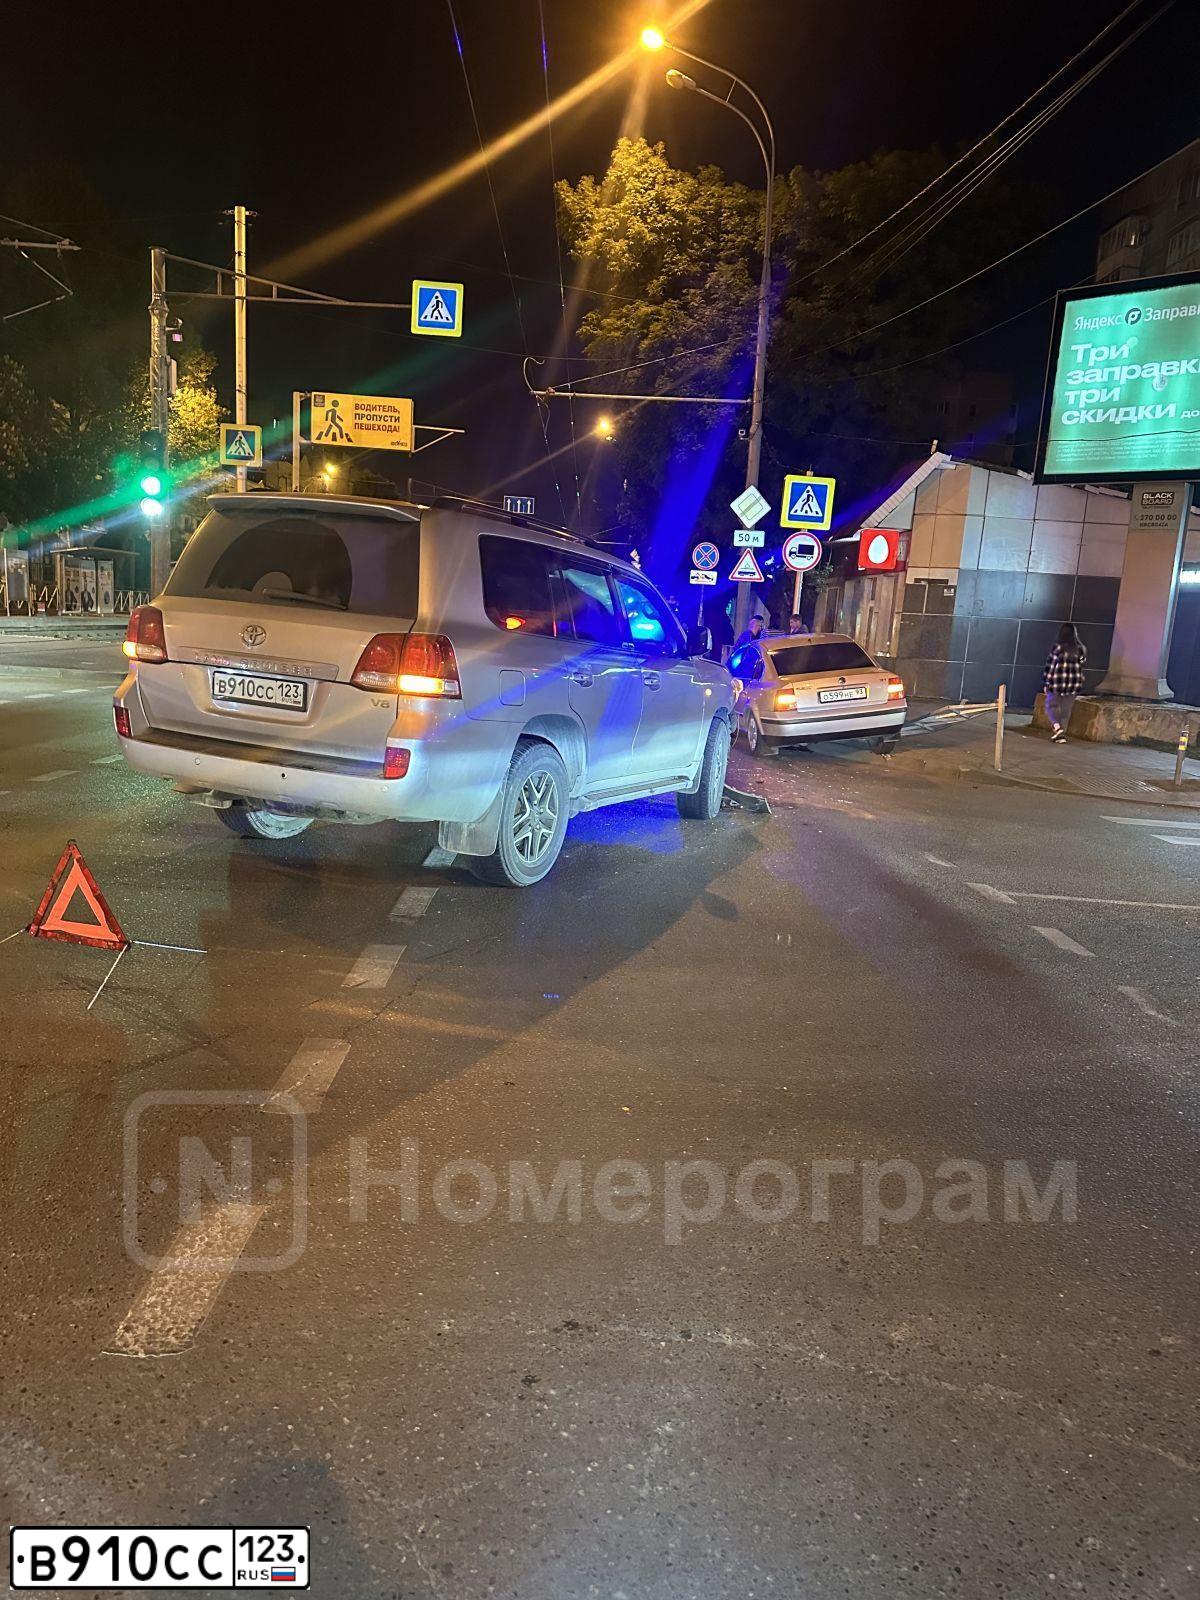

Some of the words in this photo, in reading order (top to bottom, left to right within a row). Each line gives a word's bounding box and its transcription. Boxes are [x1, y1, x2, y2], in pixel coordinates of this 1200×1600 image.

[1074, 313, 1122, 331] Яндекс
[1070, 343, 1131, 367] Три
[1066, 358, 1200, 385] заправк
[1064, 386, 1121, 409] три
[354, 403, 401, 414] ВОДИТЕЛЬ,
[354, 412, 400, 423] ПРОПУСТИ
[1061, 402, 1177, 425] скидки
[1180, 409, 1200, 419] до
[354, 422, 400, 433] ПЕШЕХОДА!
[738, 533, 751, 542] 50
[218, 677, 274, 700] В910СС
[277, 683, 300, 698] 123
